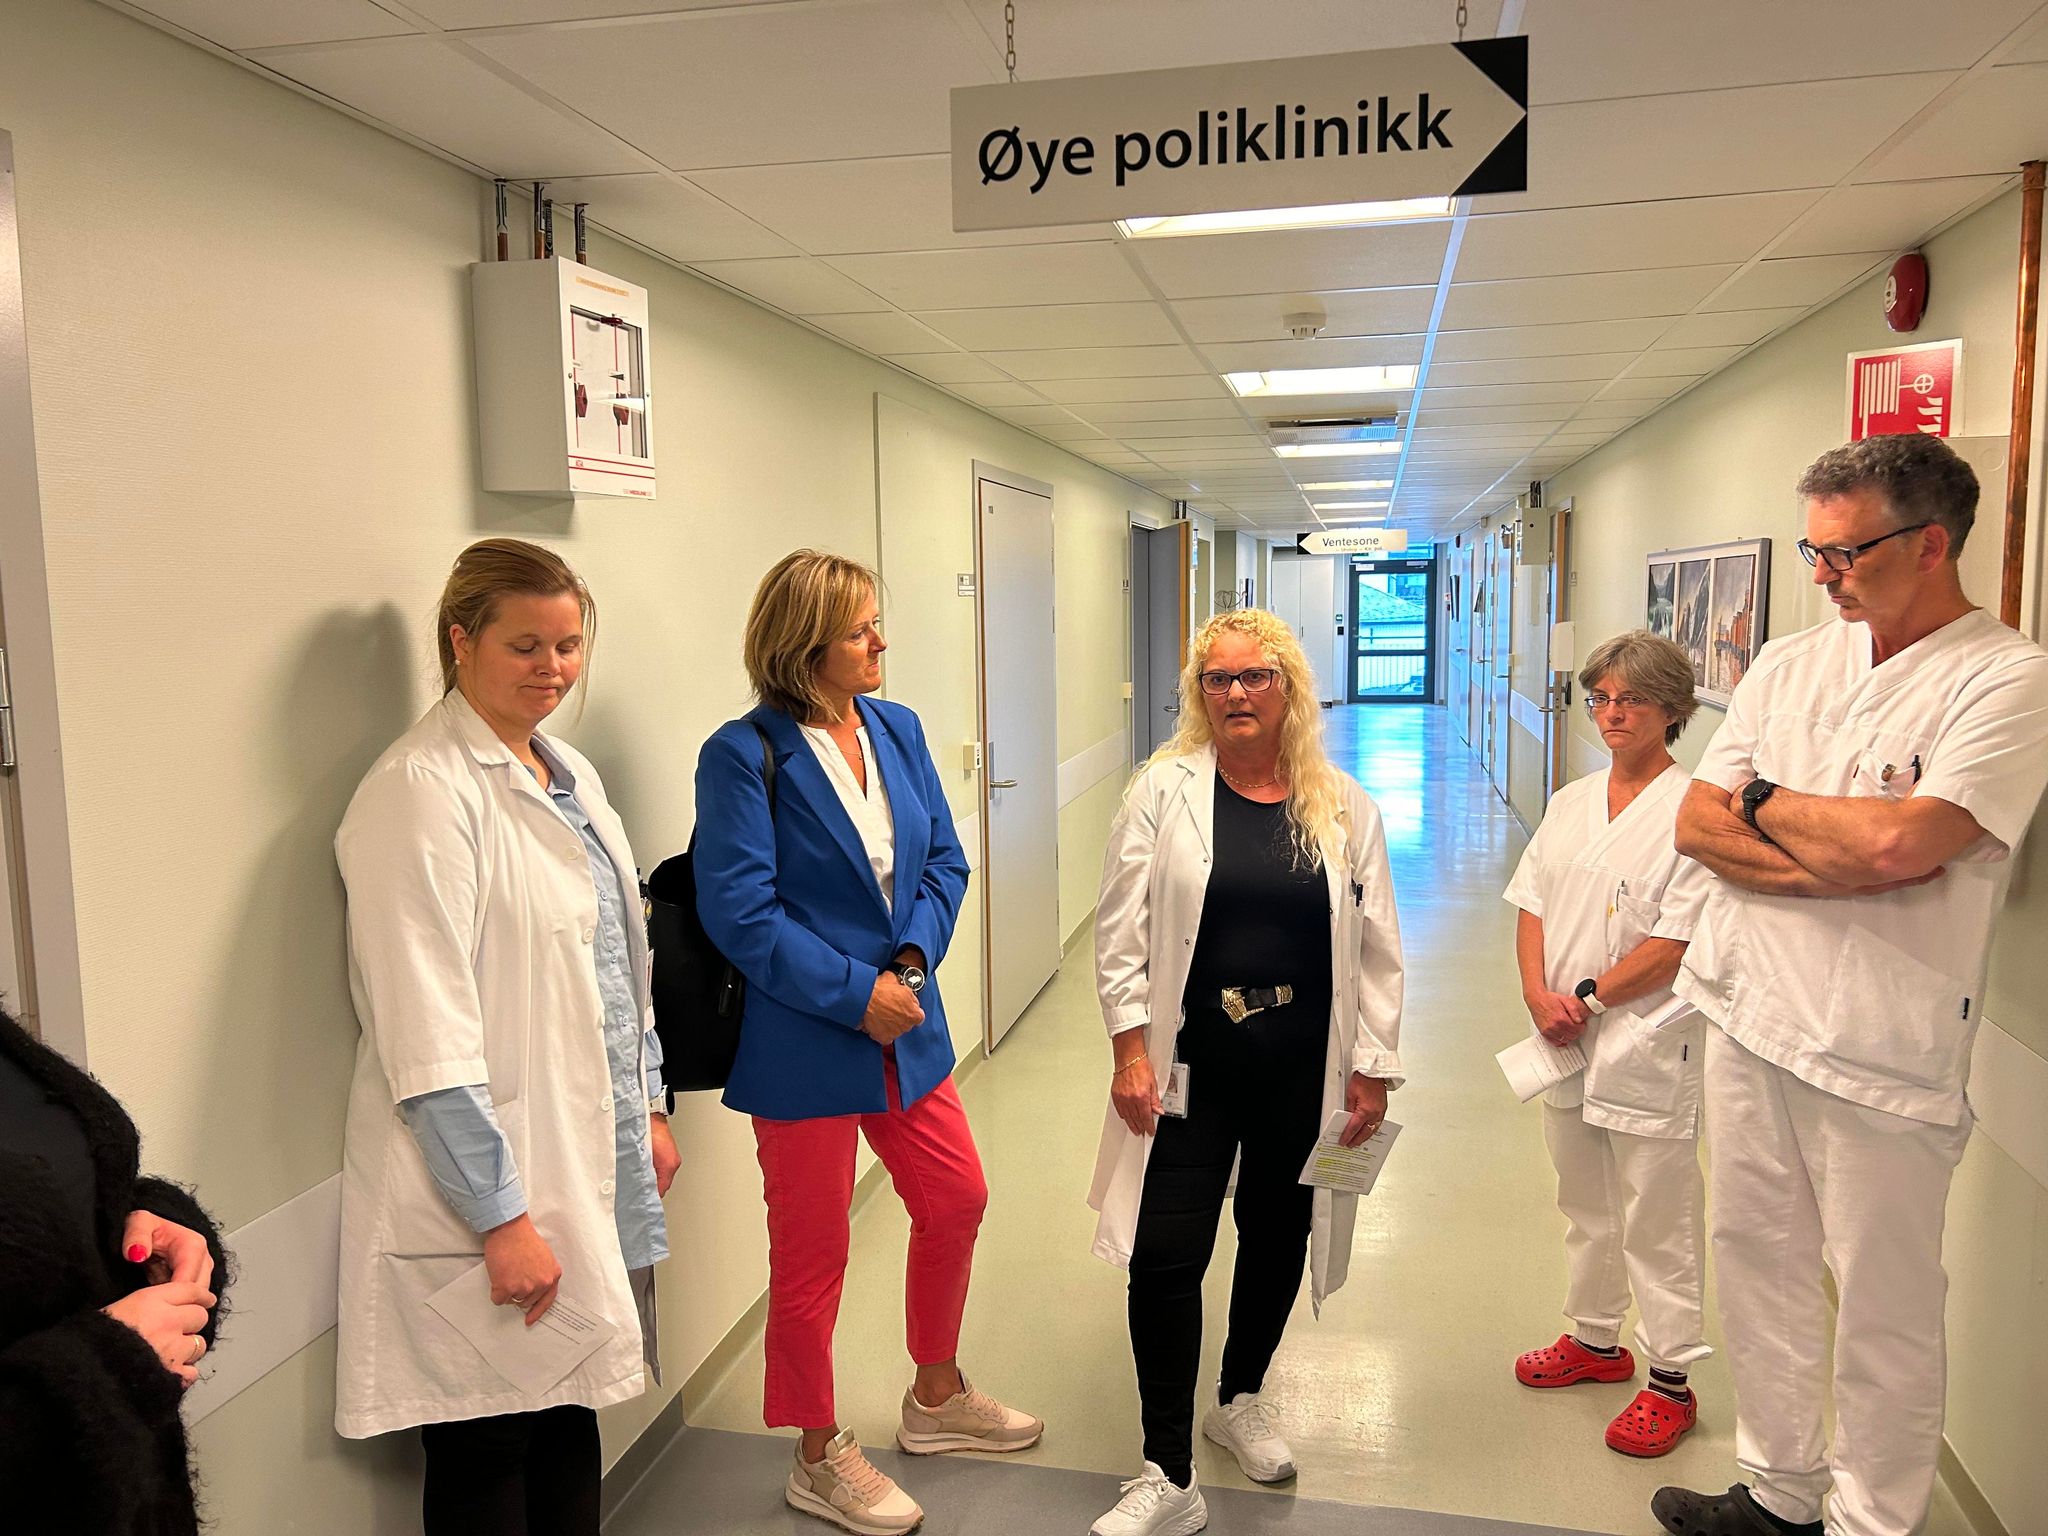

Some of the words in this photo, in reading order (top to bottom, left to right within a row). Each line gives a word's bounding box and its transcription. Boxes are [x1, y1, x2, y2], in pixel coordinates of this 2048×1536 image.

[979, 126, 1095, 194] Øye
[1115, 93, 1453, 187] poliklinikk
[1322, 537, 1379, 547] Ventesone
